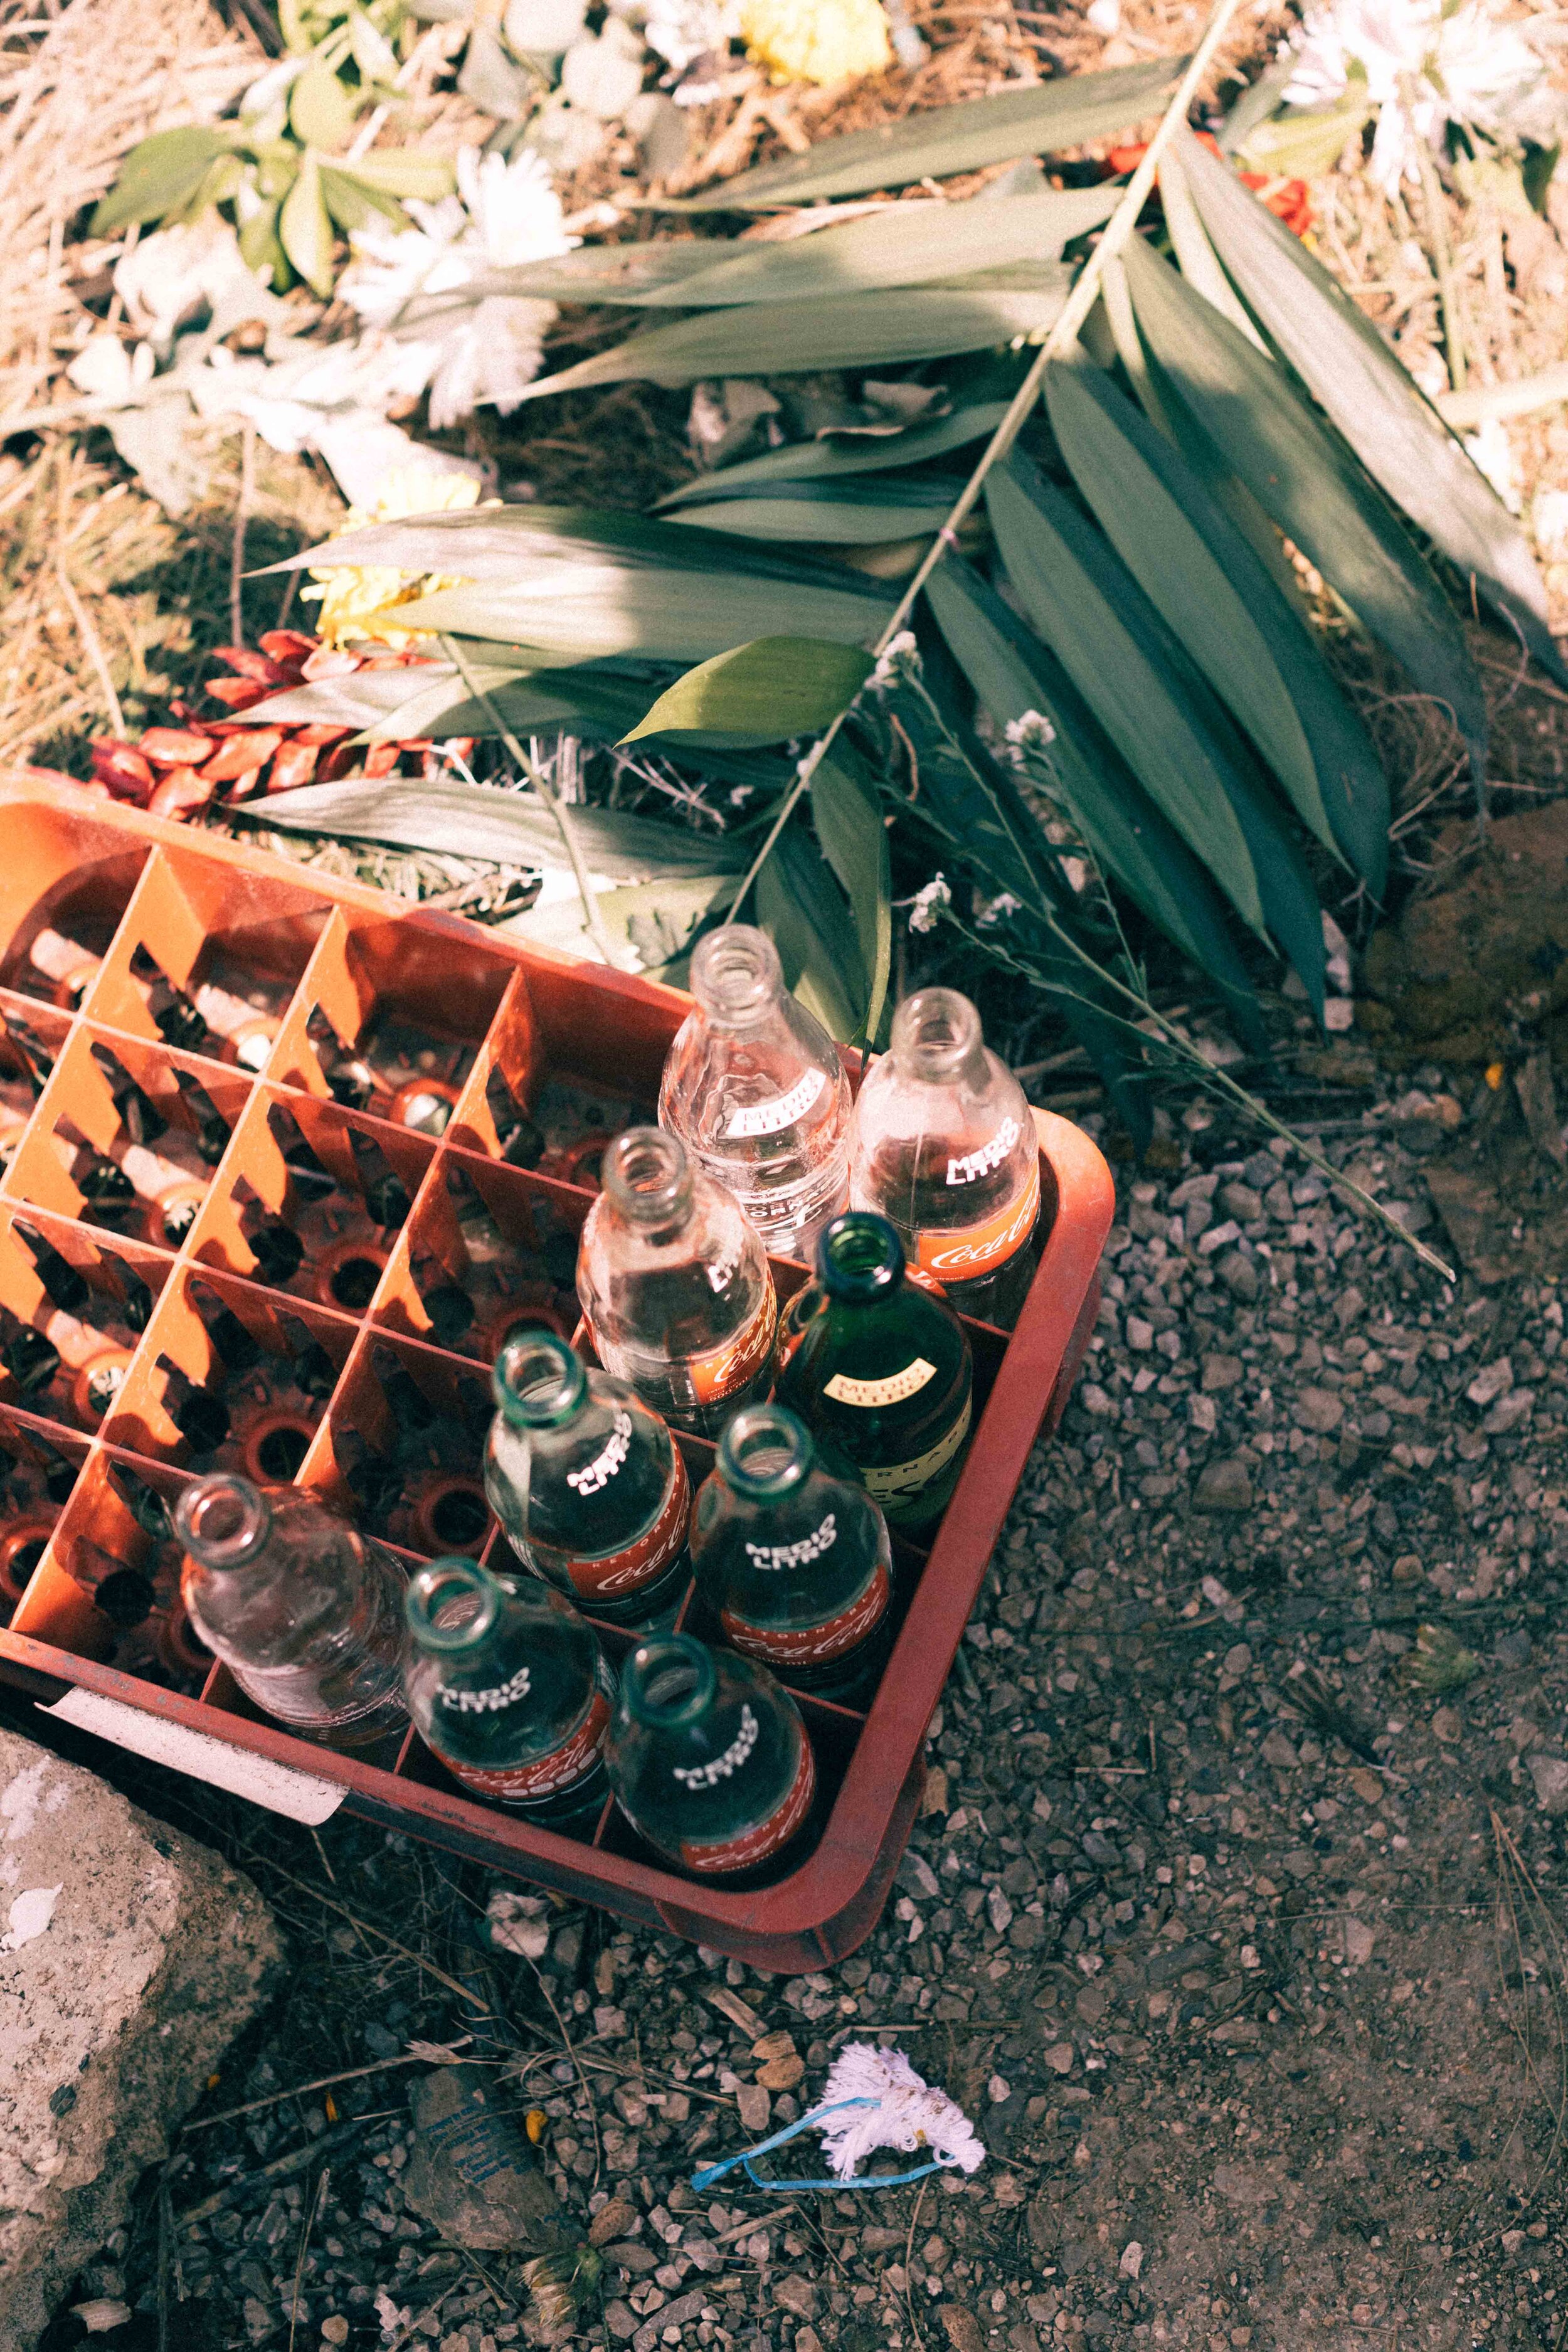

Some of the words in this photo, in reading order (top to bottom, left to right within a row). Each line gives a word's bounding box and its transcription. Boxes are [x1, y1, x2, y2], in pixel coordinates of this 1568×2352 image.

[946, 1122, 1019, 1185] LITRO
[947, 1116, 1014, 1172] MEDIO
[745, 1513, 835, 1559] MEDIO
[753, 1528, 837, 1570] LITRO
[729, 1581, 877, 1639] RETORNABLE
[437, 1666, 530, 1701] MEDIO
[442, 1682, 531, 1714] LITRO
[673, 1703, 751, 1781] MEDIO
[687, 1717, 759, 1791] LITRO
